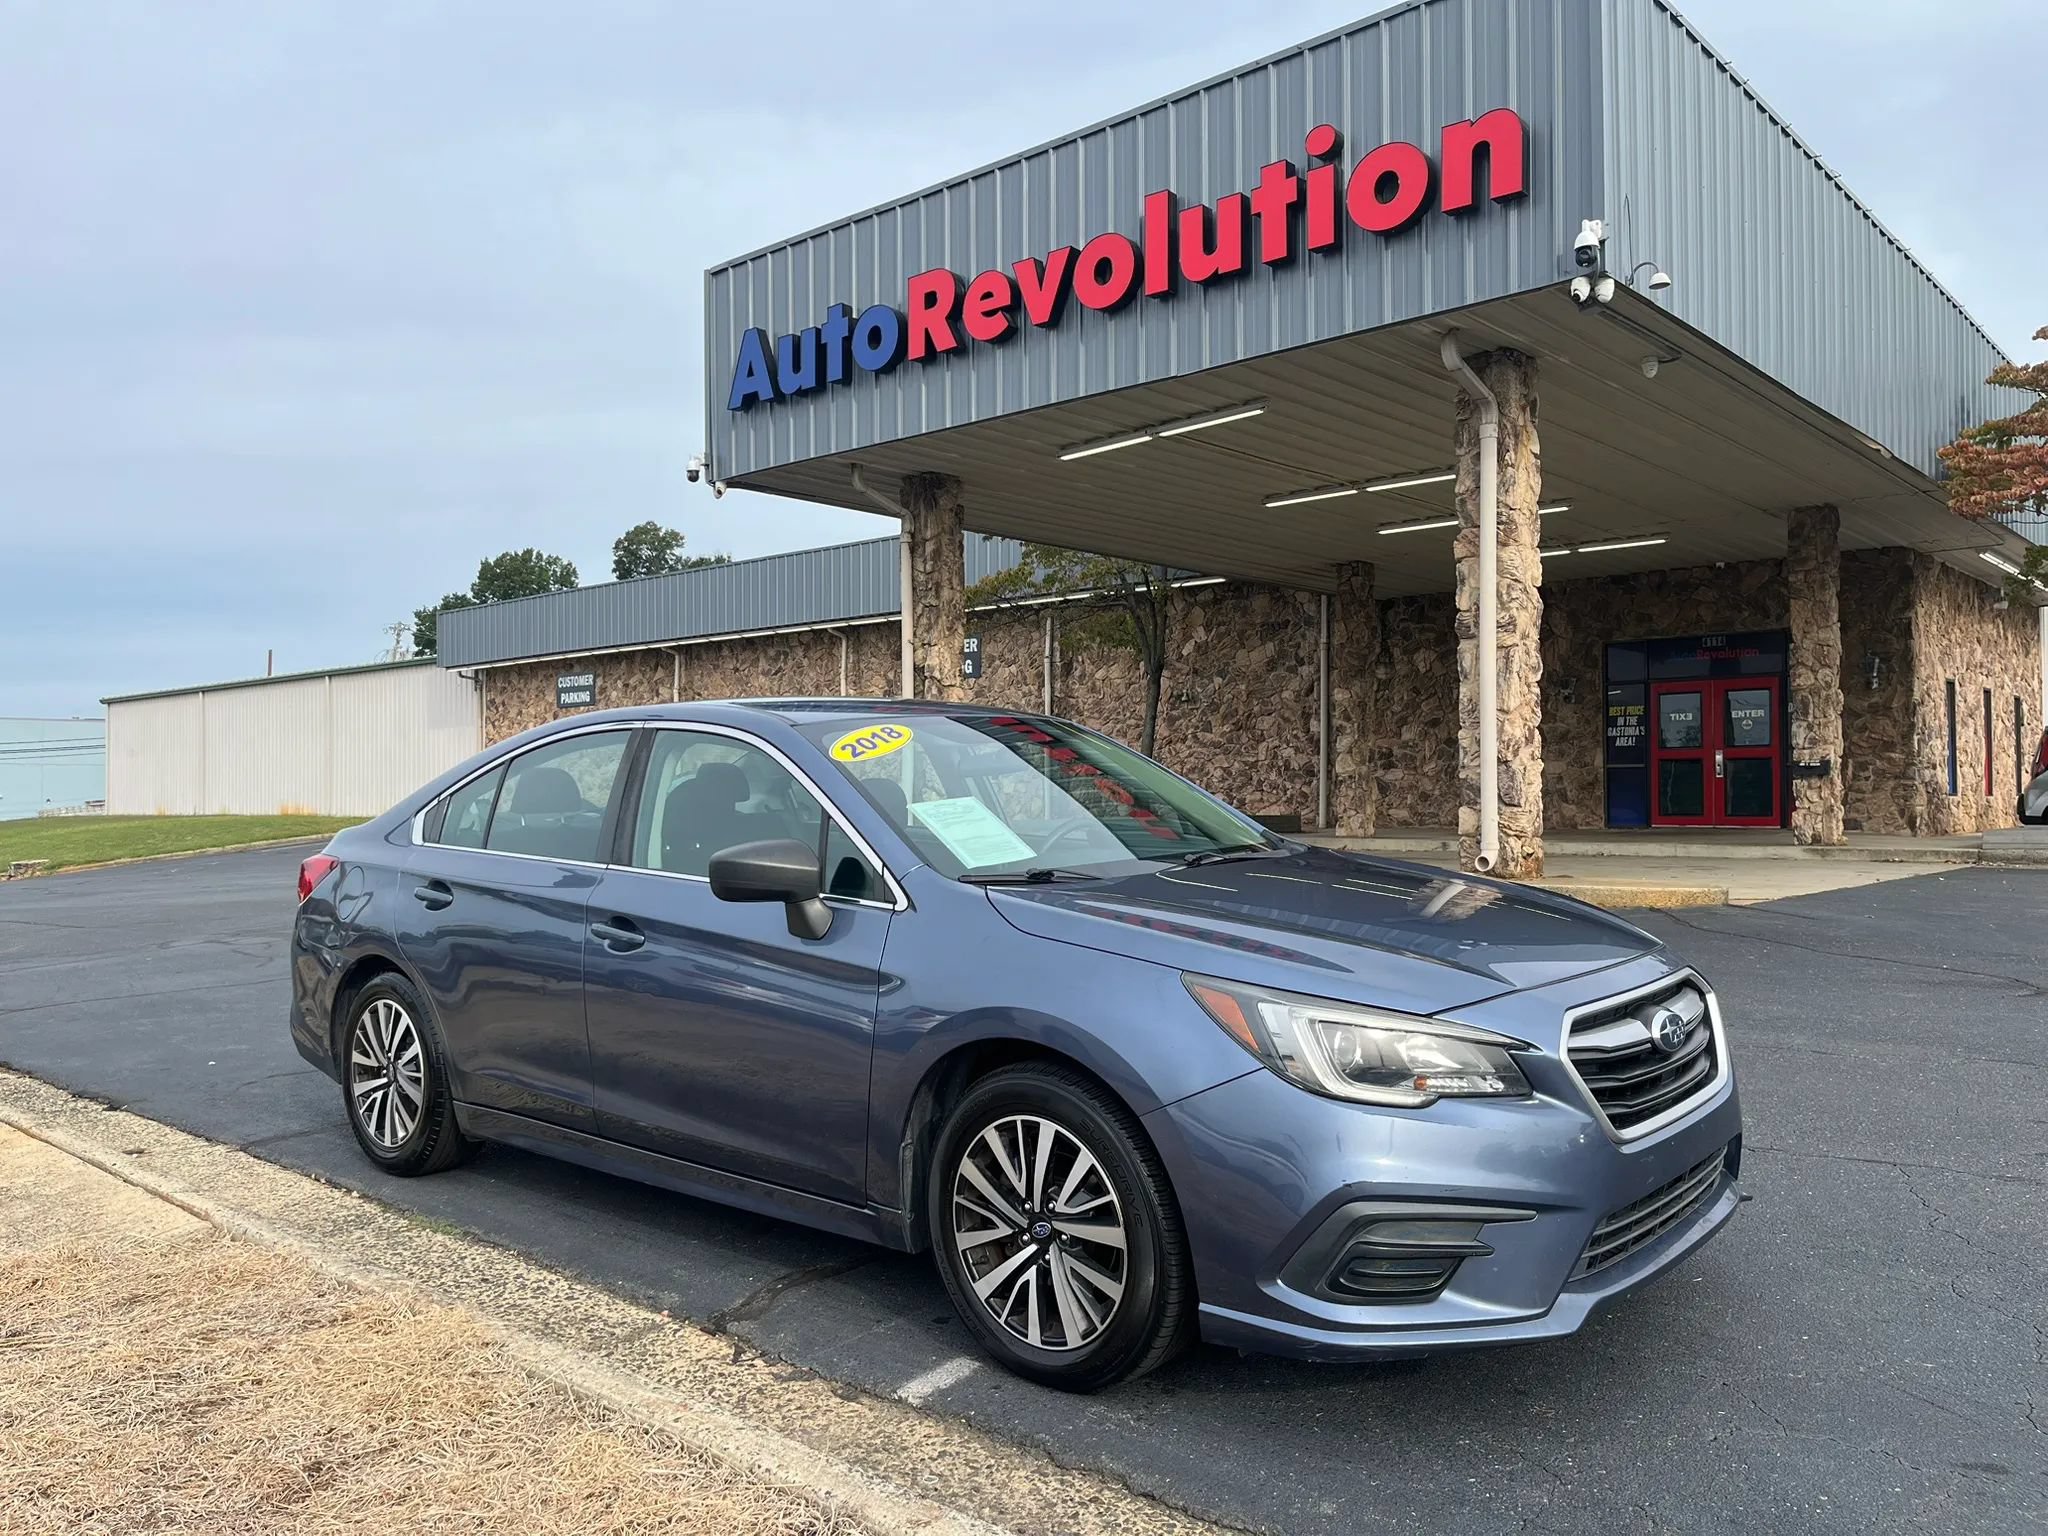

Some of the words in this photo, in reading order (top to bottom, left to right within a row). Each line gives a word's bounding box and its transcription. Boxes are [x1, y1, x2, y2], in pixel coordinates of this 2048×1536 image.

[727, 107, 1527, 411] AutoRevolution
[557, 674, 594, 688] CUSTOMER
[560, 691, 591, 704] PARKING
[1608, 706, 1625, 716] BEST
[1626, 705, 1645, 715] PRICE
[1731, 709, 1765, 718] ENTER
[1616, 716, 1625, 726] IN
[1626, 716, 1638, 726] THE
[1607, 726, 1645, 737] GASTONIA'S
[840, 726, 903, 759] 2018
[1615, 736, 1636, 747] AREA!
